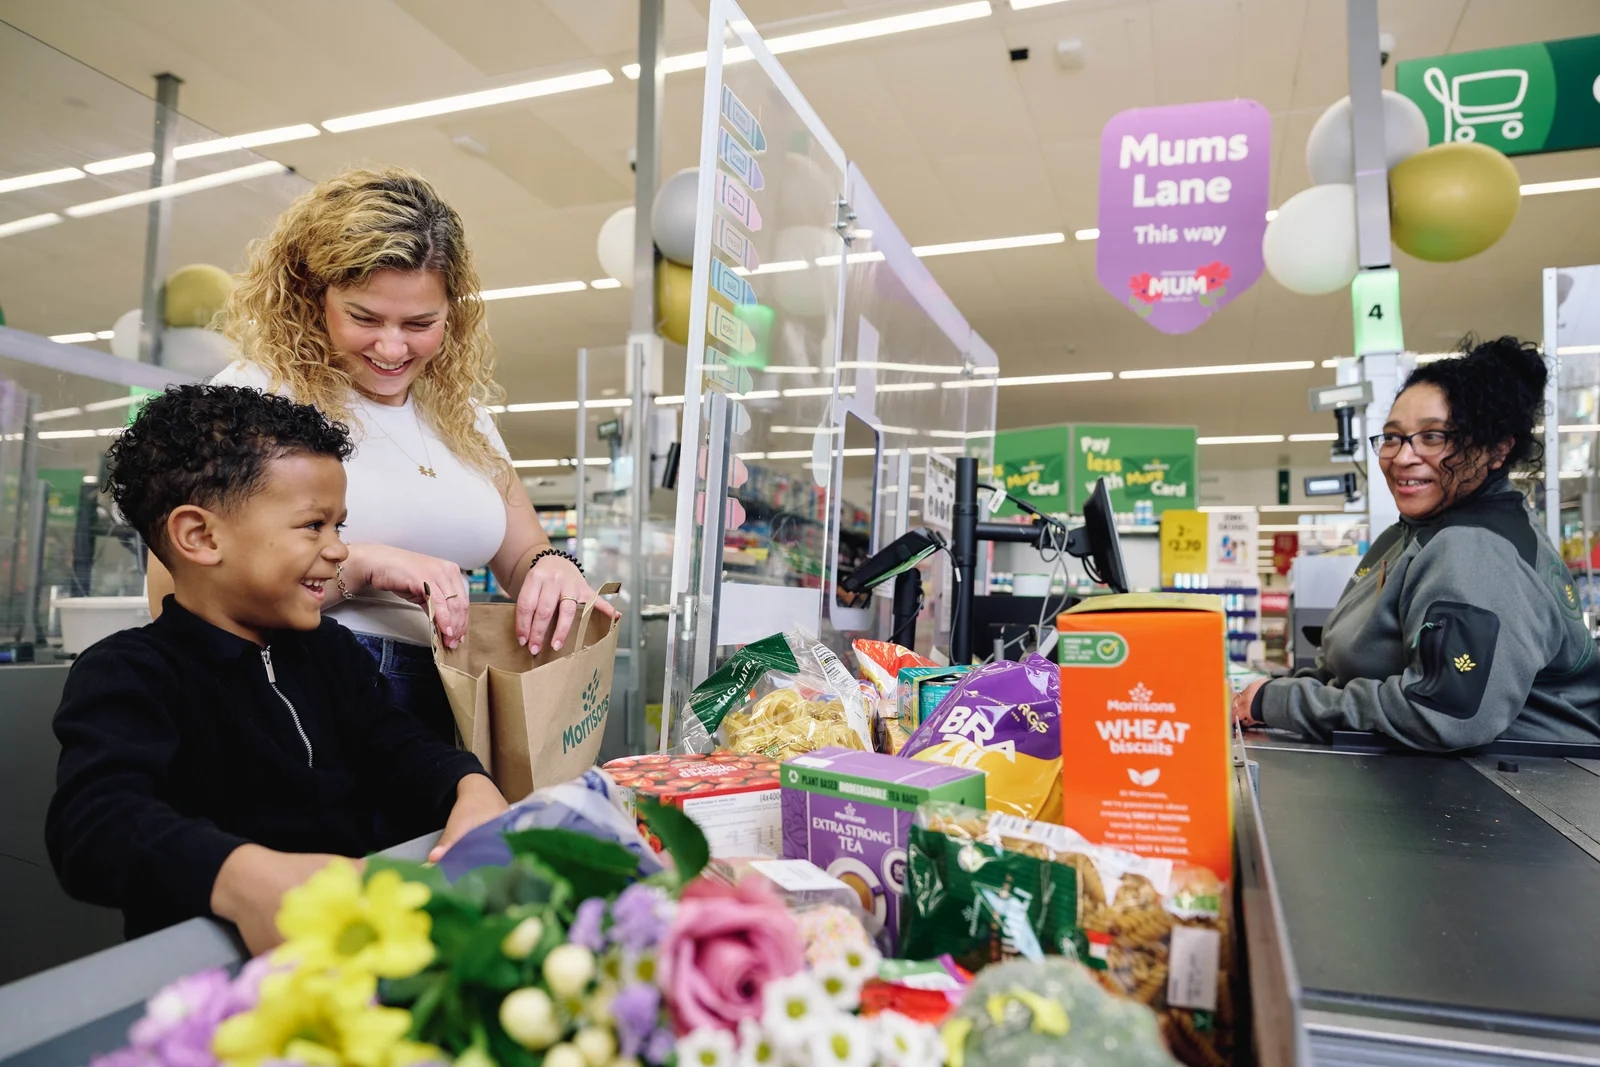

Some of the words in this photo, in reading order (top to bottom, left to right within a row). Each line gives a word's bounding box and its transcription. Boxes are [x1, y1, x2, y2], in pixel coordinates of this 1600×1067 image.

[1119, 133, 1248, 169] Mums
[1132, 174, 1232, 208] Lane
[1134, 223, 1178, 244] This
[1184, 226, 1226, 246] way
[1148, 275, 1208, 296] MUM
[1368, 304, 1384, 320] 4
[1080, 436, 1110, 454] Pay
[1087, 452, 1122, 472] less
[1027, 480, 1059, 496] Card
[1150, 481, 1186, 497] Card
[1106, 699, 1176, 714] Morrisons
[562, 694, 609, 754] Morrisons
[1095, 718, 1190, 744] WHEAT
[1110, 740, 1174, 756] biscuits
[802, 775, 818, 787] PLANT
[820, 778, 838, 790] BASED
[834, 811, 867, 825] Morrisons
[812, 817, 845, 834] EXTRA
[844, 824, 892, 846] STRONG
[838, 835, 864, 855] TEA
